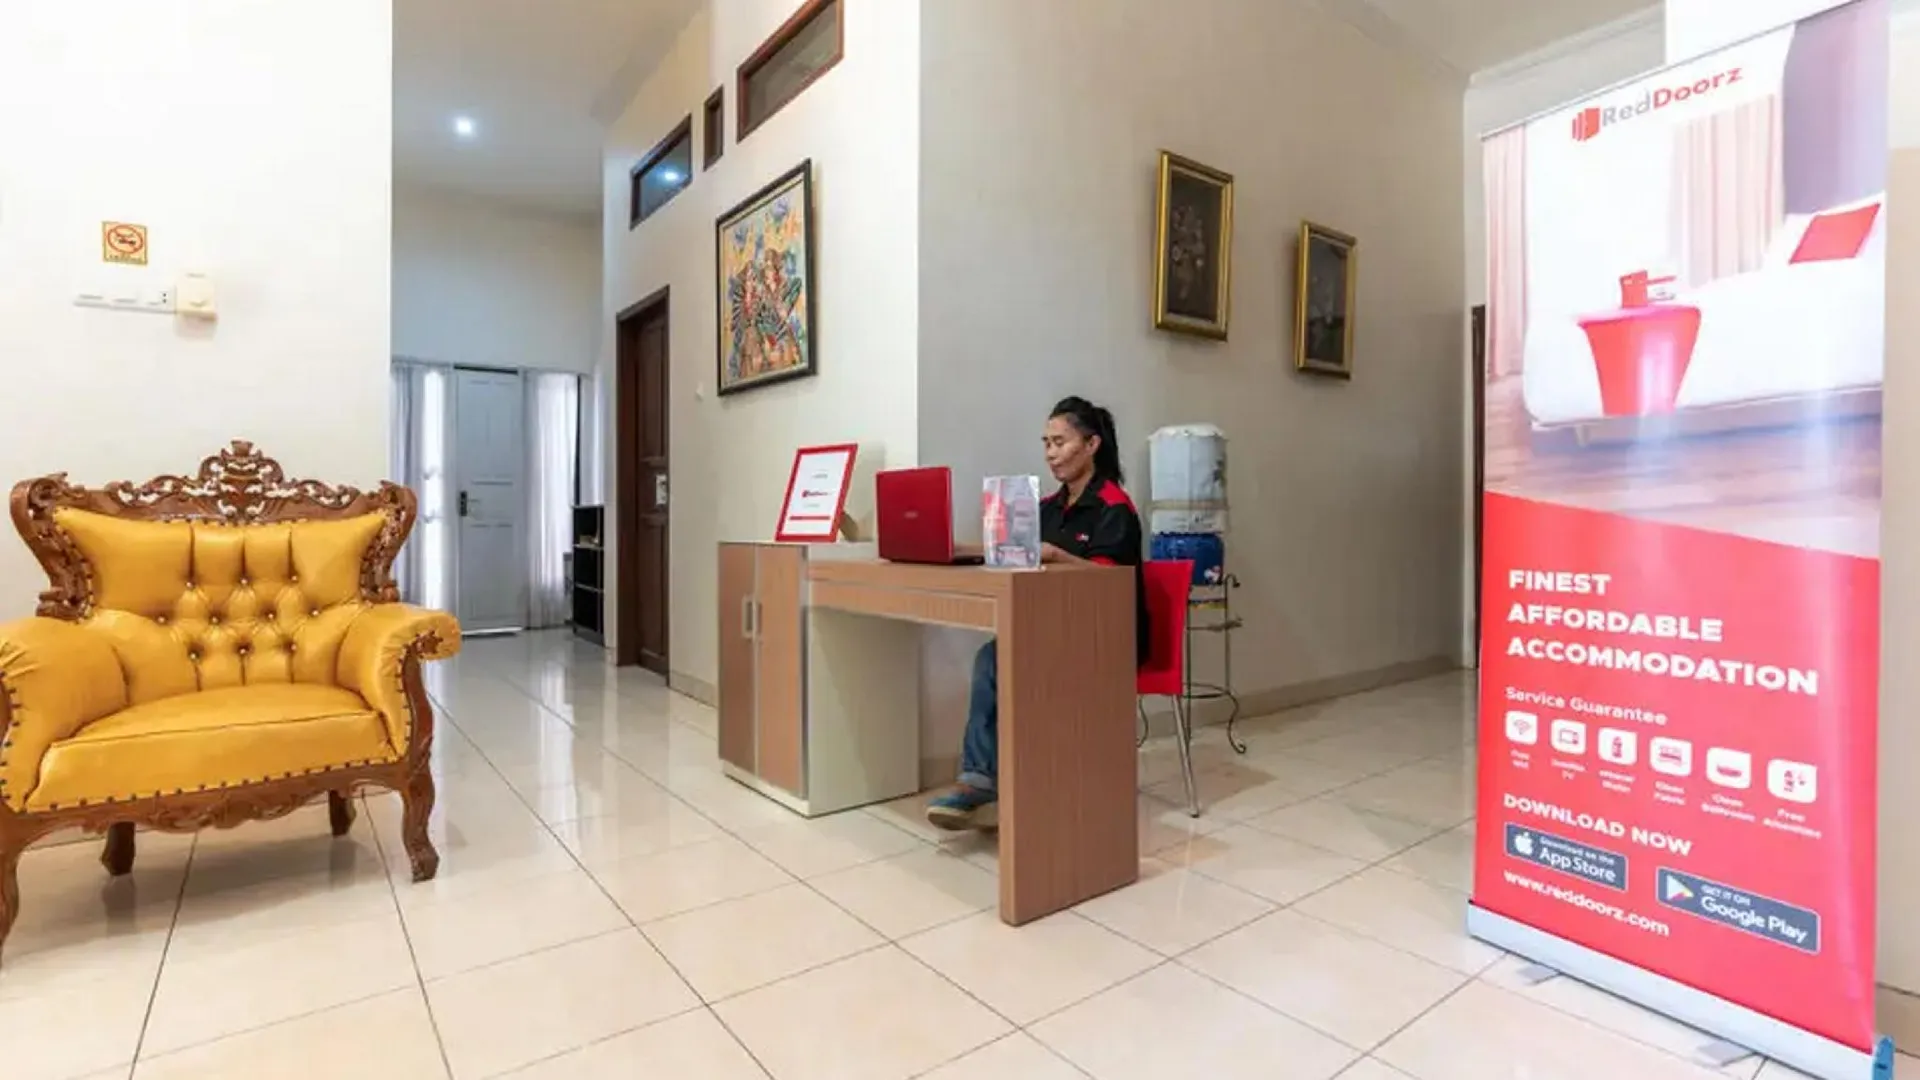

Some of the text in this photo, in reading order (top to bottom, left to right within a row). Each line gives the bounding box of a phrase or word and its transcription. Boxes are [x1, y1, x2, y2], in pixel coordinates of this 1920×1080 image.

[1602, 67, 1743, 127] RedDoorz
[1508, 569, 1612, 596] FINEST
[1506, 603, 1724, 643] AFFORDABLE
[1506, 637, 1819, 696] ACCOMMODATION
[1505, 686, 1668, 726] Service Guarantee
[1503, 793, 1692, 856] DOWNLOAD NOW
[1539, 846, 1616, 882] App Store
[1540, 835, 1584, 857] Download
[1503, 870, 1670, 936] www.reddoorz.com
[1700, 884, 1721, 899] GET
[1701, 896, 1808, 944] Google Play
